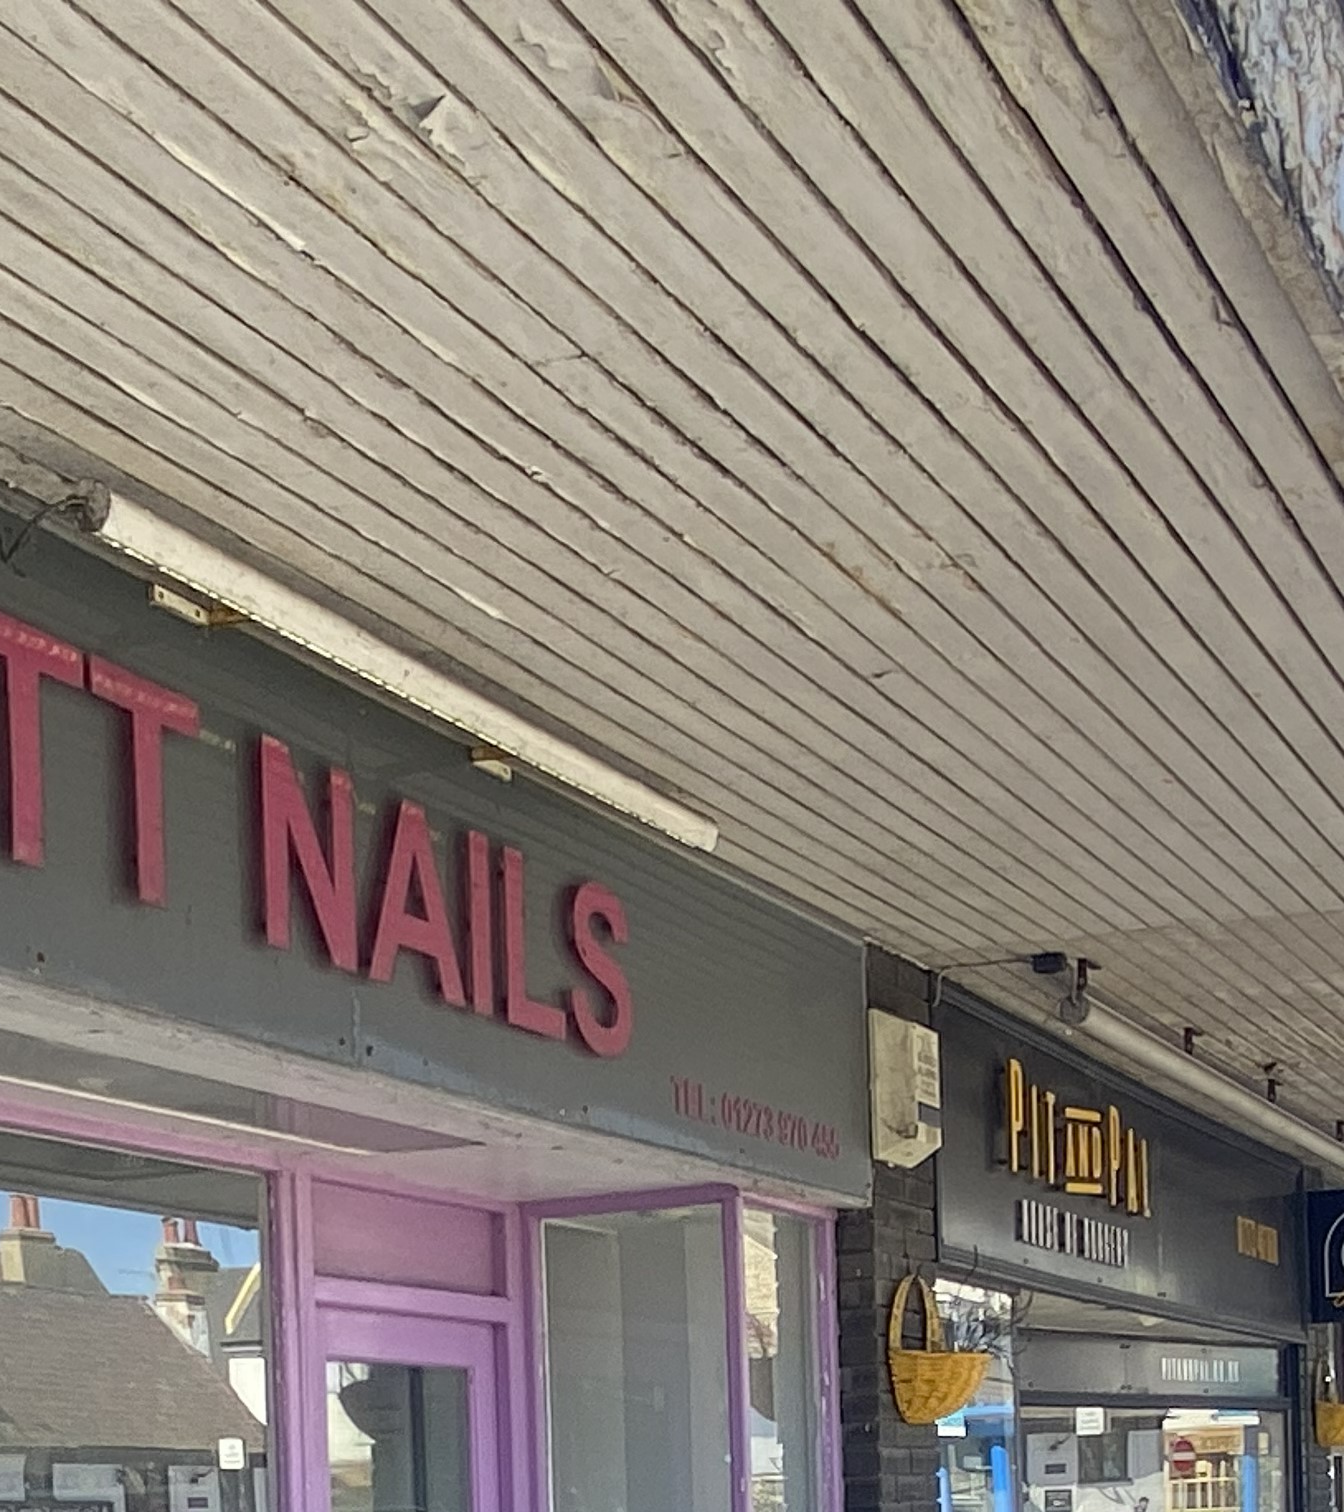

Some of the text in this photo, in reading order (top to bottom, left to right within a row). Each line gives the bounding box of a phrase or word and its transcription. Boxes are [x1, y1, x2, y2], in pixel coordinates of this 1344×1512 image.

[259, 733, 636, 1057] NAILS
[721, 1092, 774, 1141] 01273
[1009, 1058, 1056, 1184] PIT
[1065, 1122, 1103, 1180] AND
[1109, 1104, 1153, 1218] PAL
